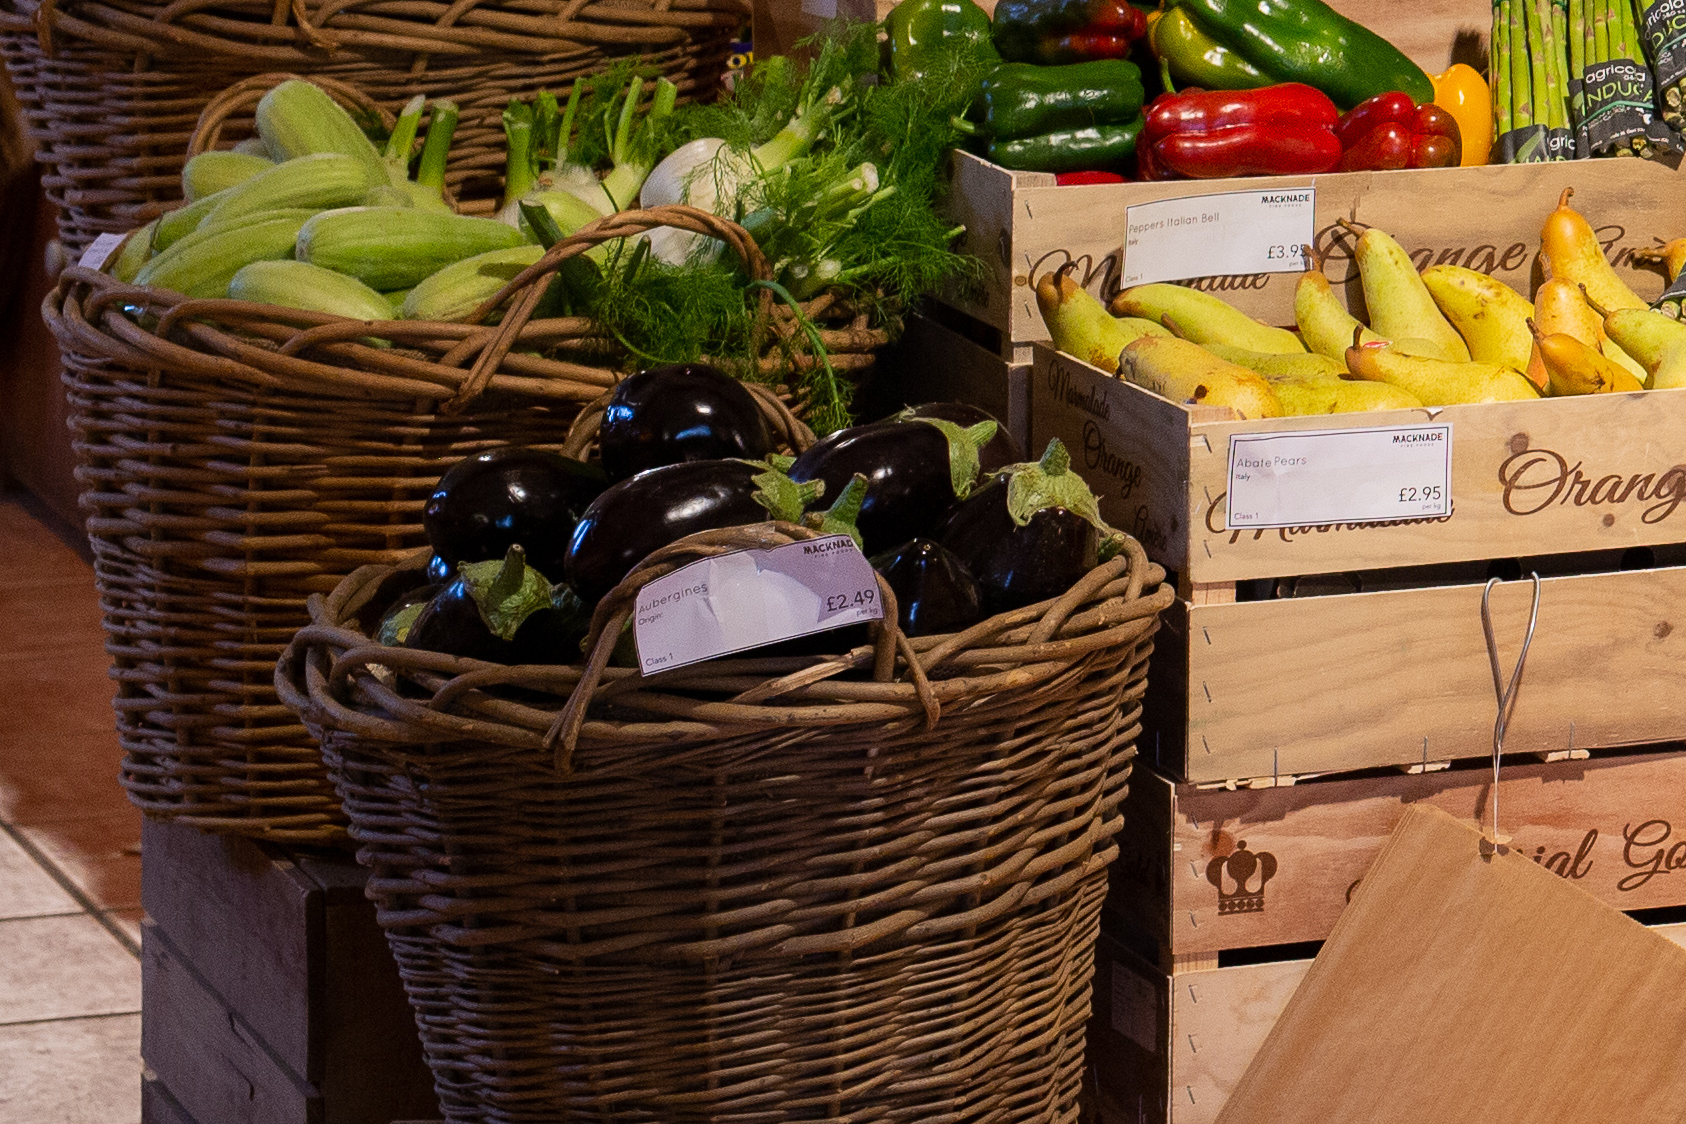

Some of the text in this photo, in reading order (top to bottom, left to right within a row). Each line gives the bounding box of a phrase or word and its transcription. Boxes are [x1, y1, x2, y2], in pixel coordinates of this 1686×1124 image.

[1586, 65, 1645, 84] agricoa
[1261, 194, 1310, 204] MACKNADE
[1128, 212, 1220, 234] Peppers Italian Bell
[1314, 221, 1528, 284] Oange
[1393, 433, 1443, 444] MACKNADE
[1236, 456, 1307, 468] Abate Pears
[1235, 473, 1250, 481] Italy
[1399, 486, 1441, 502] £2.95
[638, 583, 708, 615] Aubergines
[826, 589, 875, 613] £2.49
[638, 612, 664, 625] Origin:
[645, 655, 668, 667] Class
